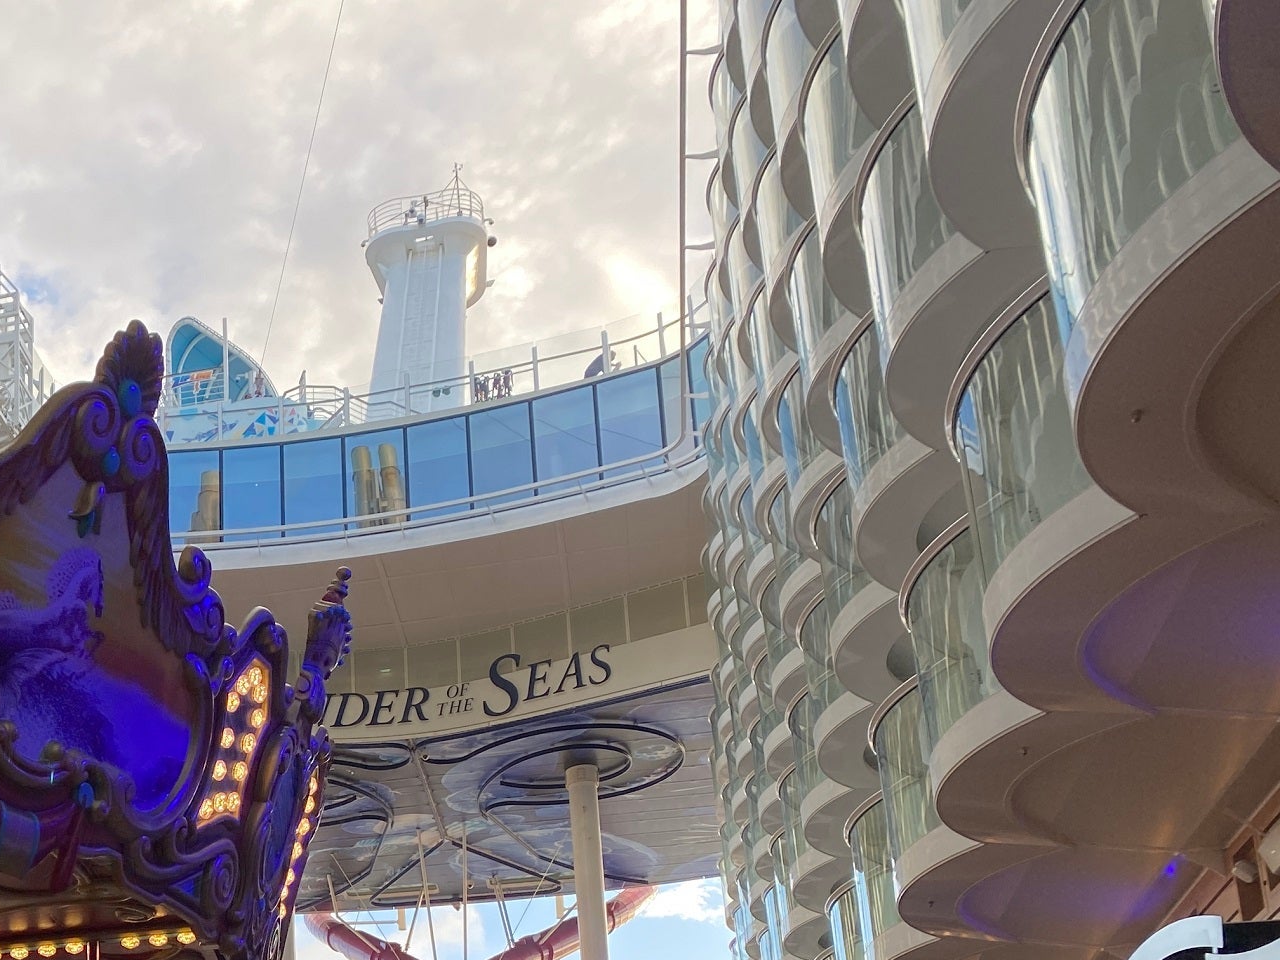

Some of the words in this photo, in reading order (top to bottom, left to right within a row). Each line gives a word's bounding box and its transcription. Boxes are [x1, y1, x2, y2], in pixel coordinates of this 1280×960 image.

[483, 644, 612, 717] SEAS
[446, 682, 470, 699] OF
[437, 698, 475, 717] THE
